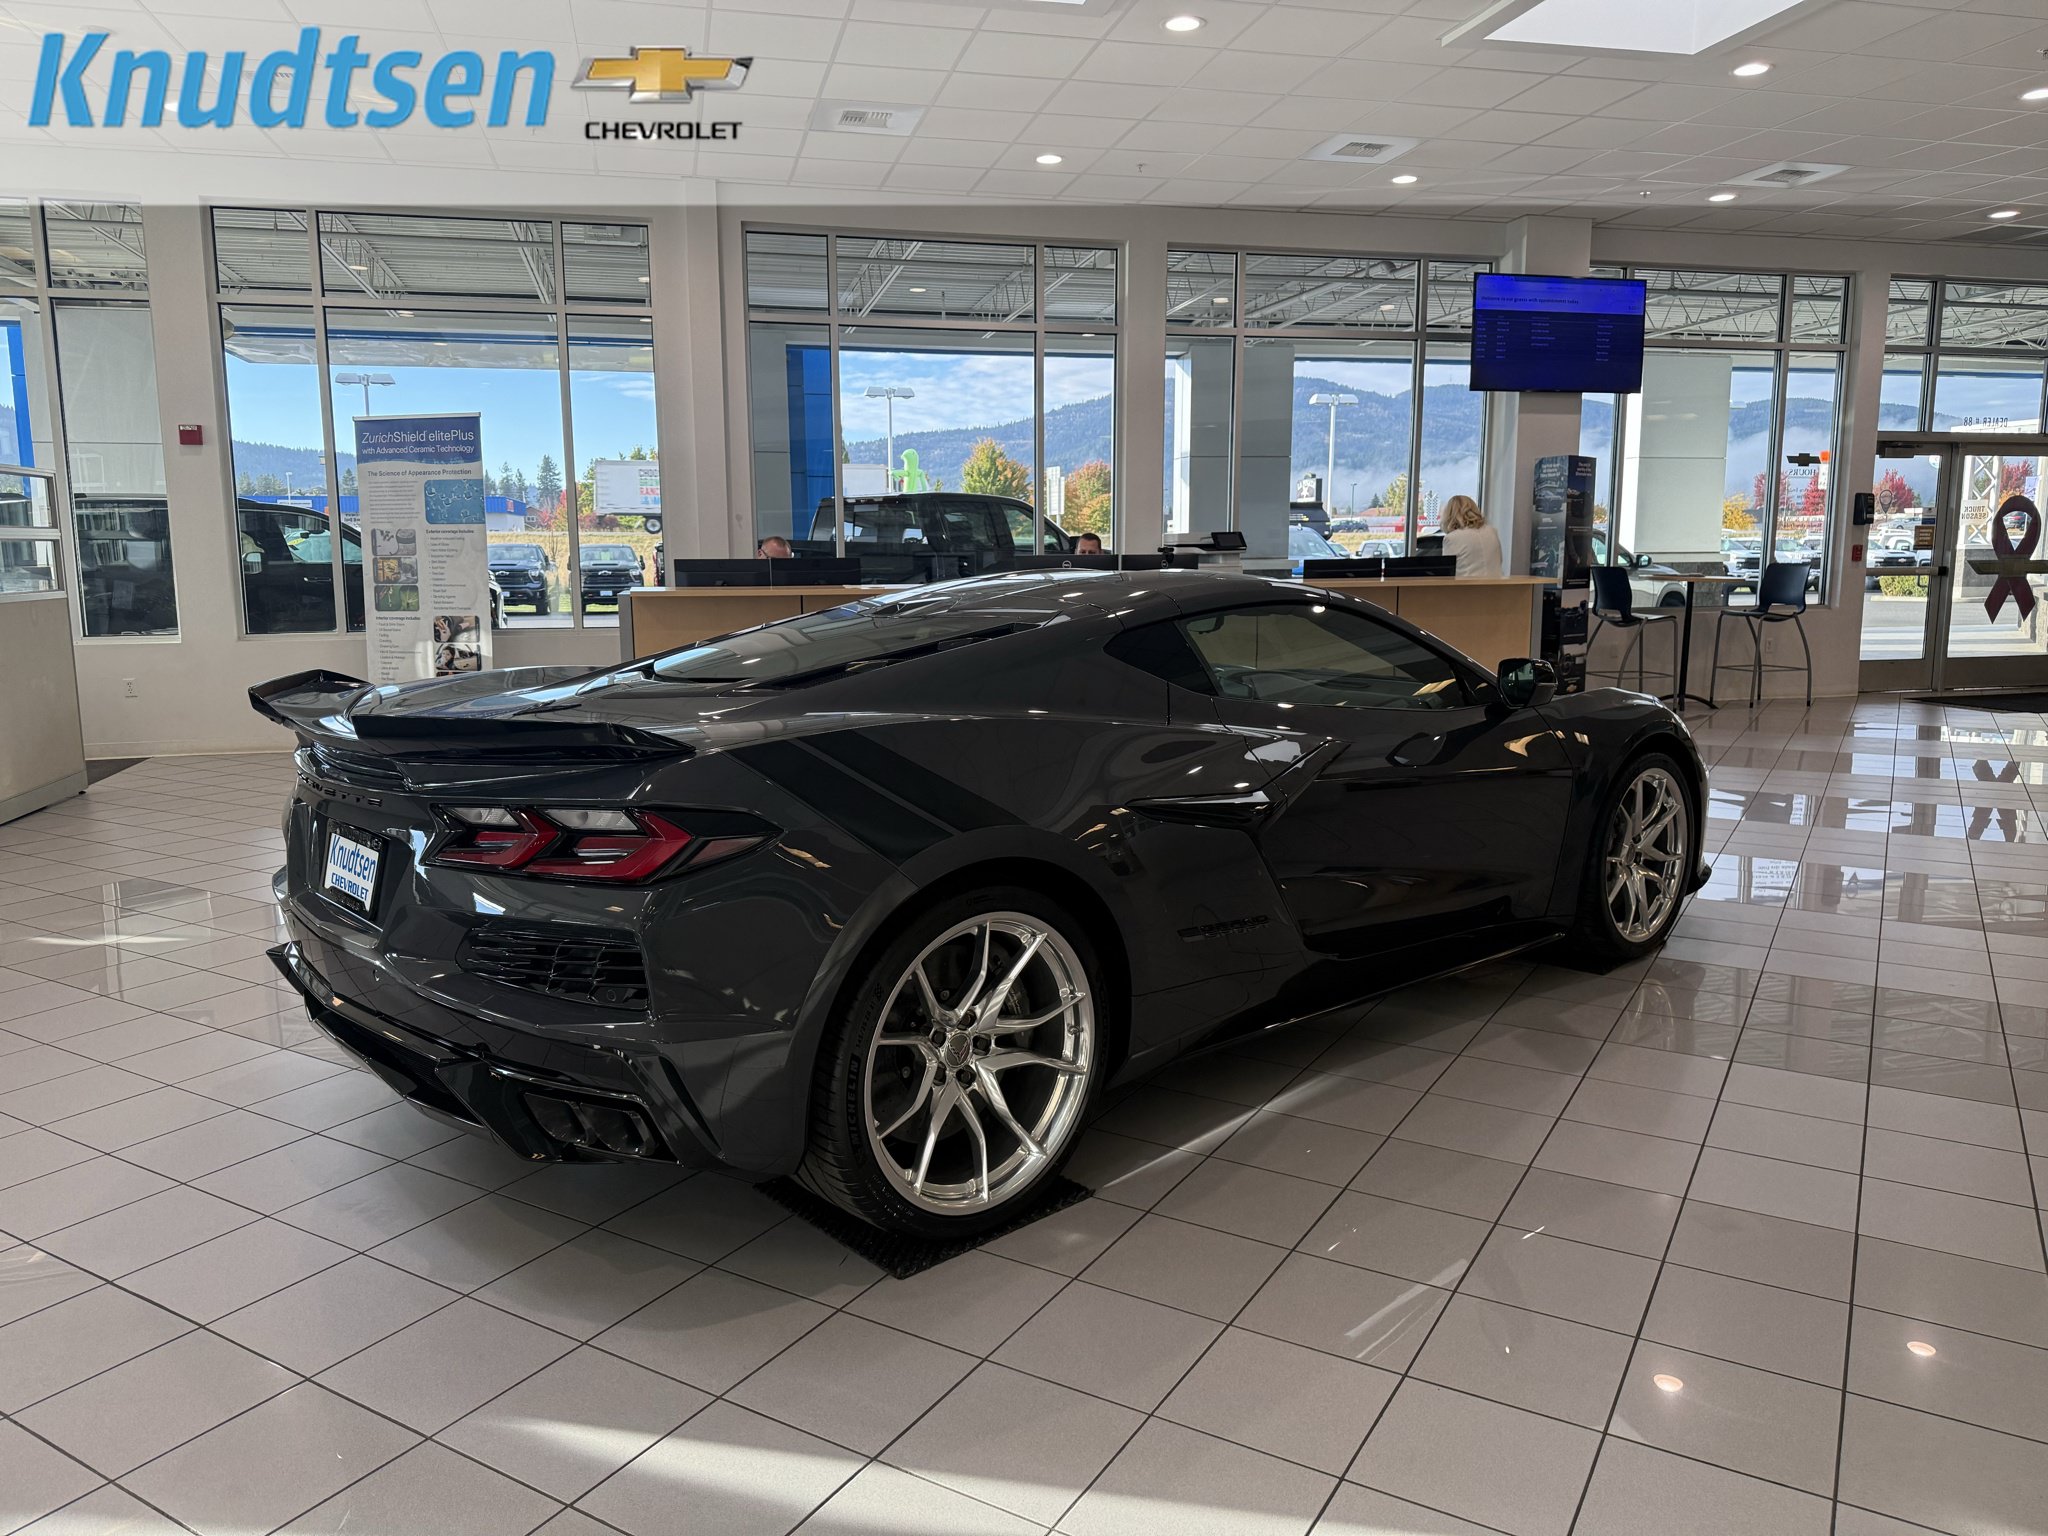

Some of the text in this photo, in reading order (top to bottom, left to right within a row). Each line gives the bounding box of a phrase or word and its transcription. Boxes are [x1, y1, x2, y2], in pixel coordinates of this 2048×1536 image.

[361, 444, 475, 455] with Advanced Ceramic Technology
[428, 429, 475, 442] elitePlus
[408, 469, 442, 477] Appearance
[442, 468, 472, 476] Protection
[297, 770, 383, 808] VETTE
[329, 835, 377, 884] Knudtsen
[331, 872, 369, 901] CHEVROLET
[846, 1057, 862, 1147] MICHELIN
